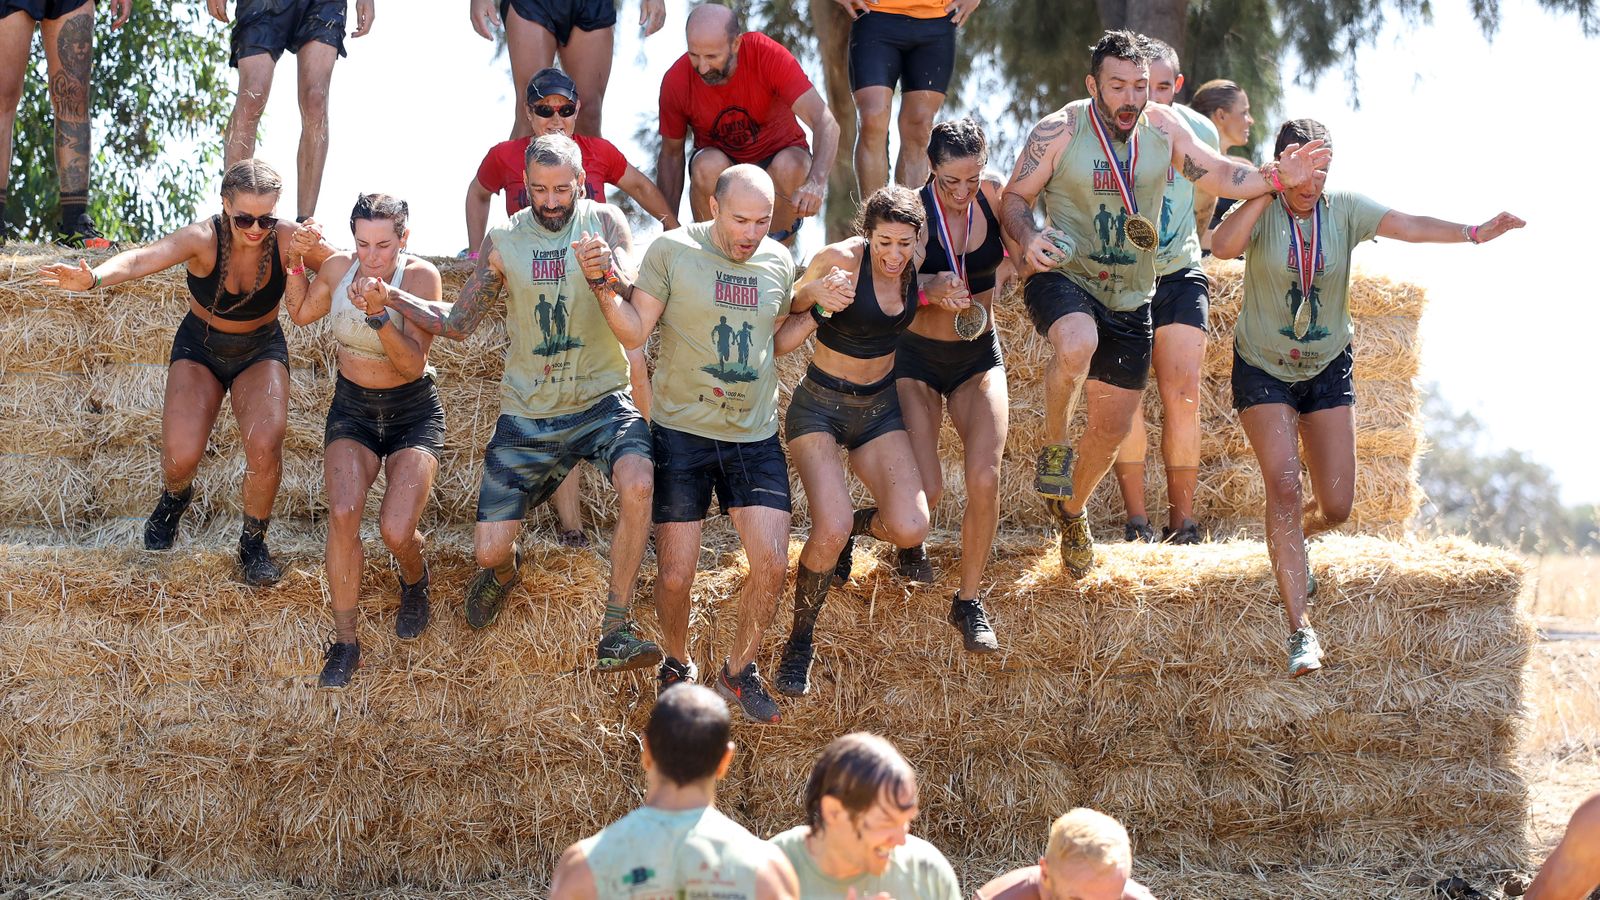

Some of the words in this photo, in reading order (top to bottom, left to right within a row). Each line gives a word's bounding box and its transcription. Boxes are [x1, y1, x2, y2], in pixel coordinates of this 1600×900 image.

[1093, 160, 1100, 169] V
[533, 250, 539, 258] V
[716, 270, 722, 280] V
[723, 273, 747, 284] carrera
[749, 276, 758, 285] del
[715, 281, 758, 305] BARRO
